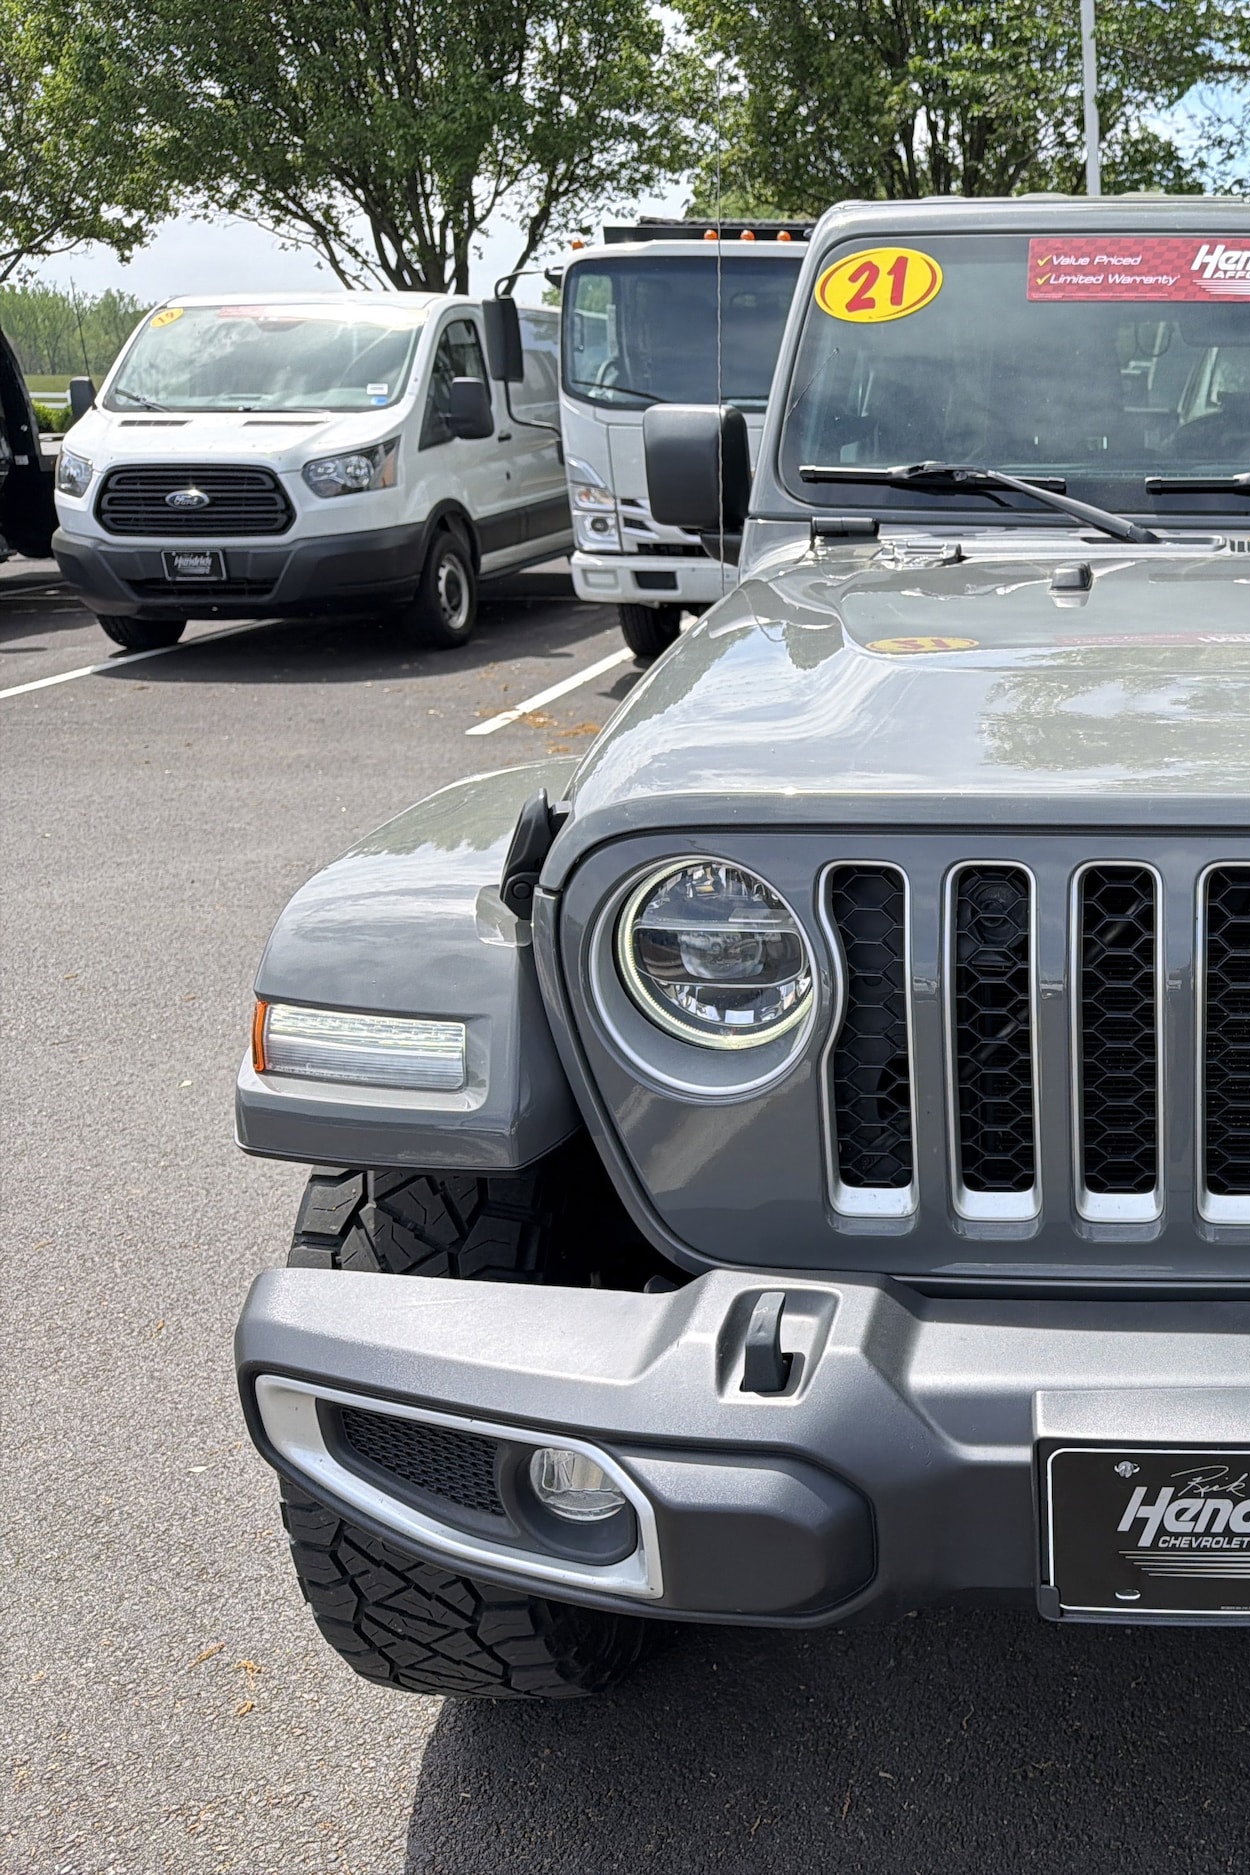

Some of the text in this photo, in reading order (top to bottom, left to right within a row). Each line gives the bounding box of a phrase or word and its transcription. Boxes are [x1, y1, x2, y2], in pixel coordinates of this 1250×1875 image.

[1052, 255, 1142, 266] Value Priced
[845, 255, 909, 313] 21
[1050, 274, 1104, 285] Limited
